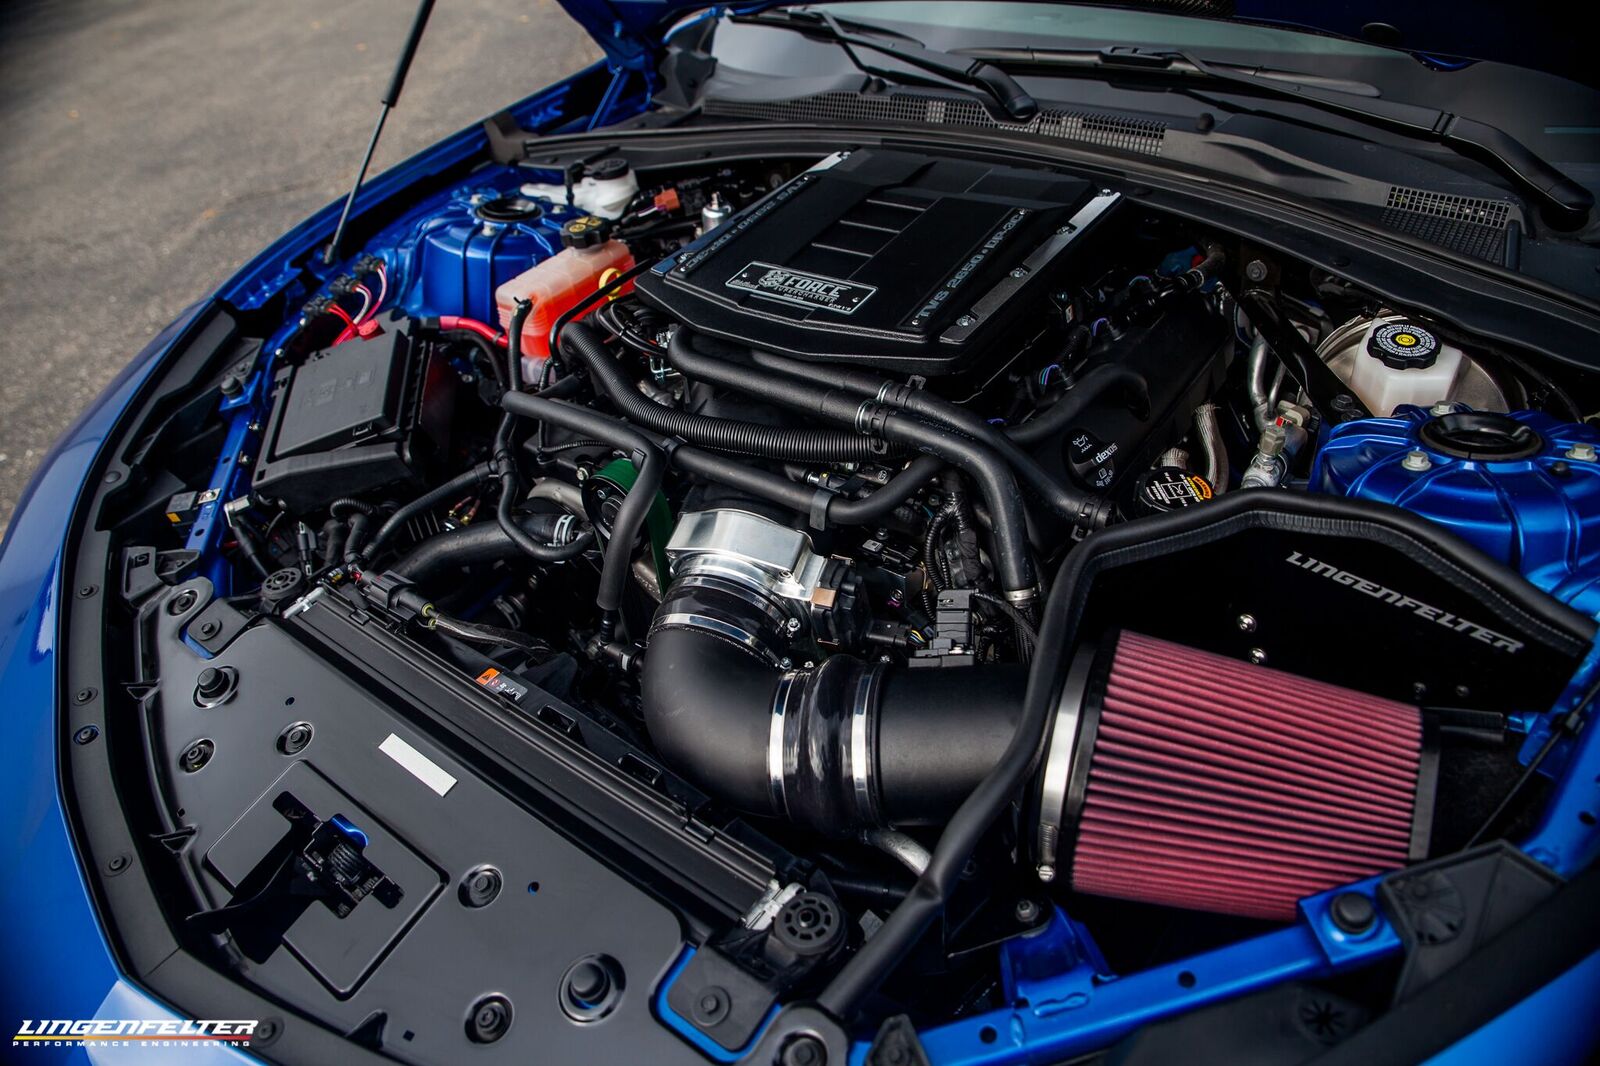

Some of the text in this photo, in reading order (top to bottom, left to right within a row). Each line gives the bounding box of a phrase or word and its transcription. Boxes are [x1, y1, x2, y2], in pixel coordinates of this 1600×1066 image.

[915, 290, 950, 318] TVS
[946, 254, 985, 289] 2650
[1095, 442, 1119, 464] dexos
[1285, 550, 1527, 655] LINGENFELTER
